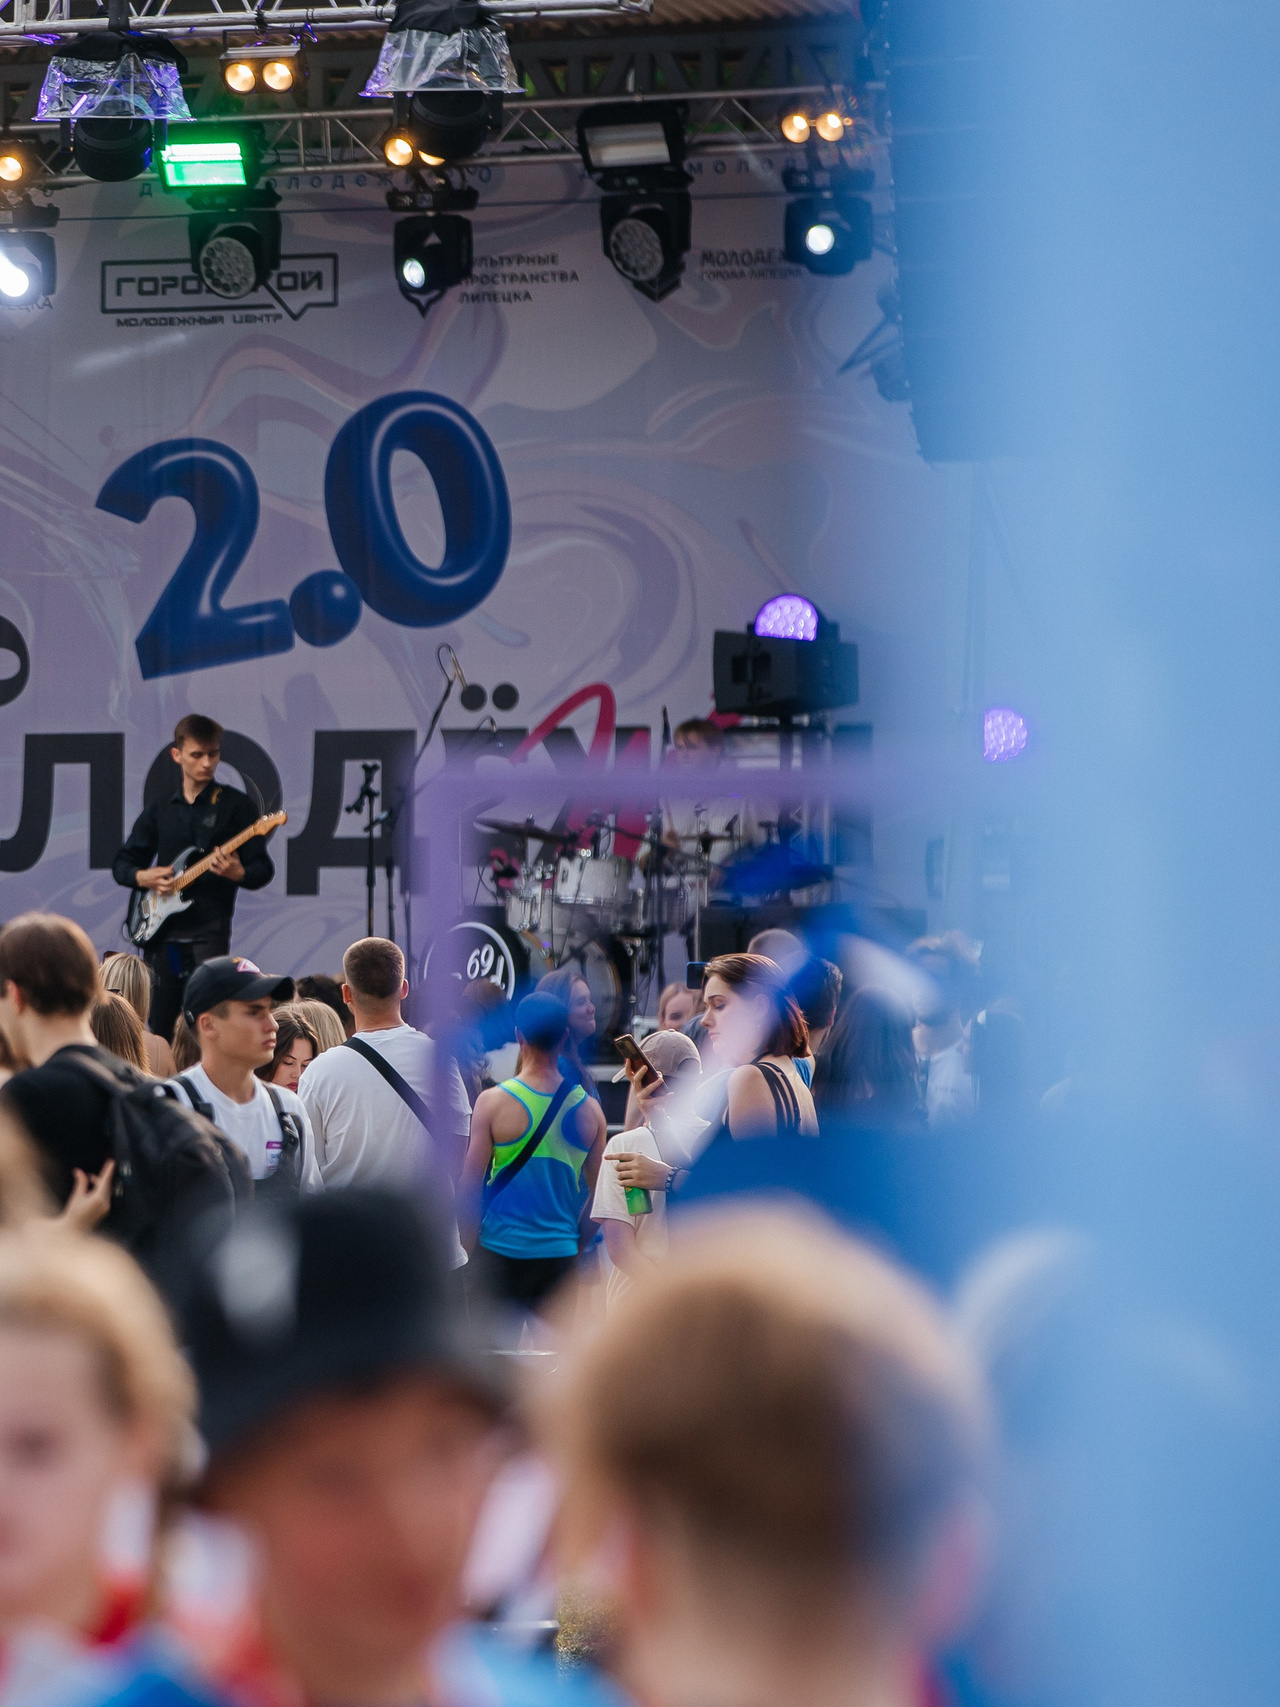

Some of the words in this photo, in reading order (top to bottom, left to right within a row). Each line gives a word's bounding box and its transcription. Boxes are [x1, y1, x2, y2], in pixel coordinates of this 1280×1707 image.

[460, 290, 533, 304] ЛИПЕЦКА
[232, 312, 284, 326] ЦЕНТР
[94, 390, 512, 681] 2.0
